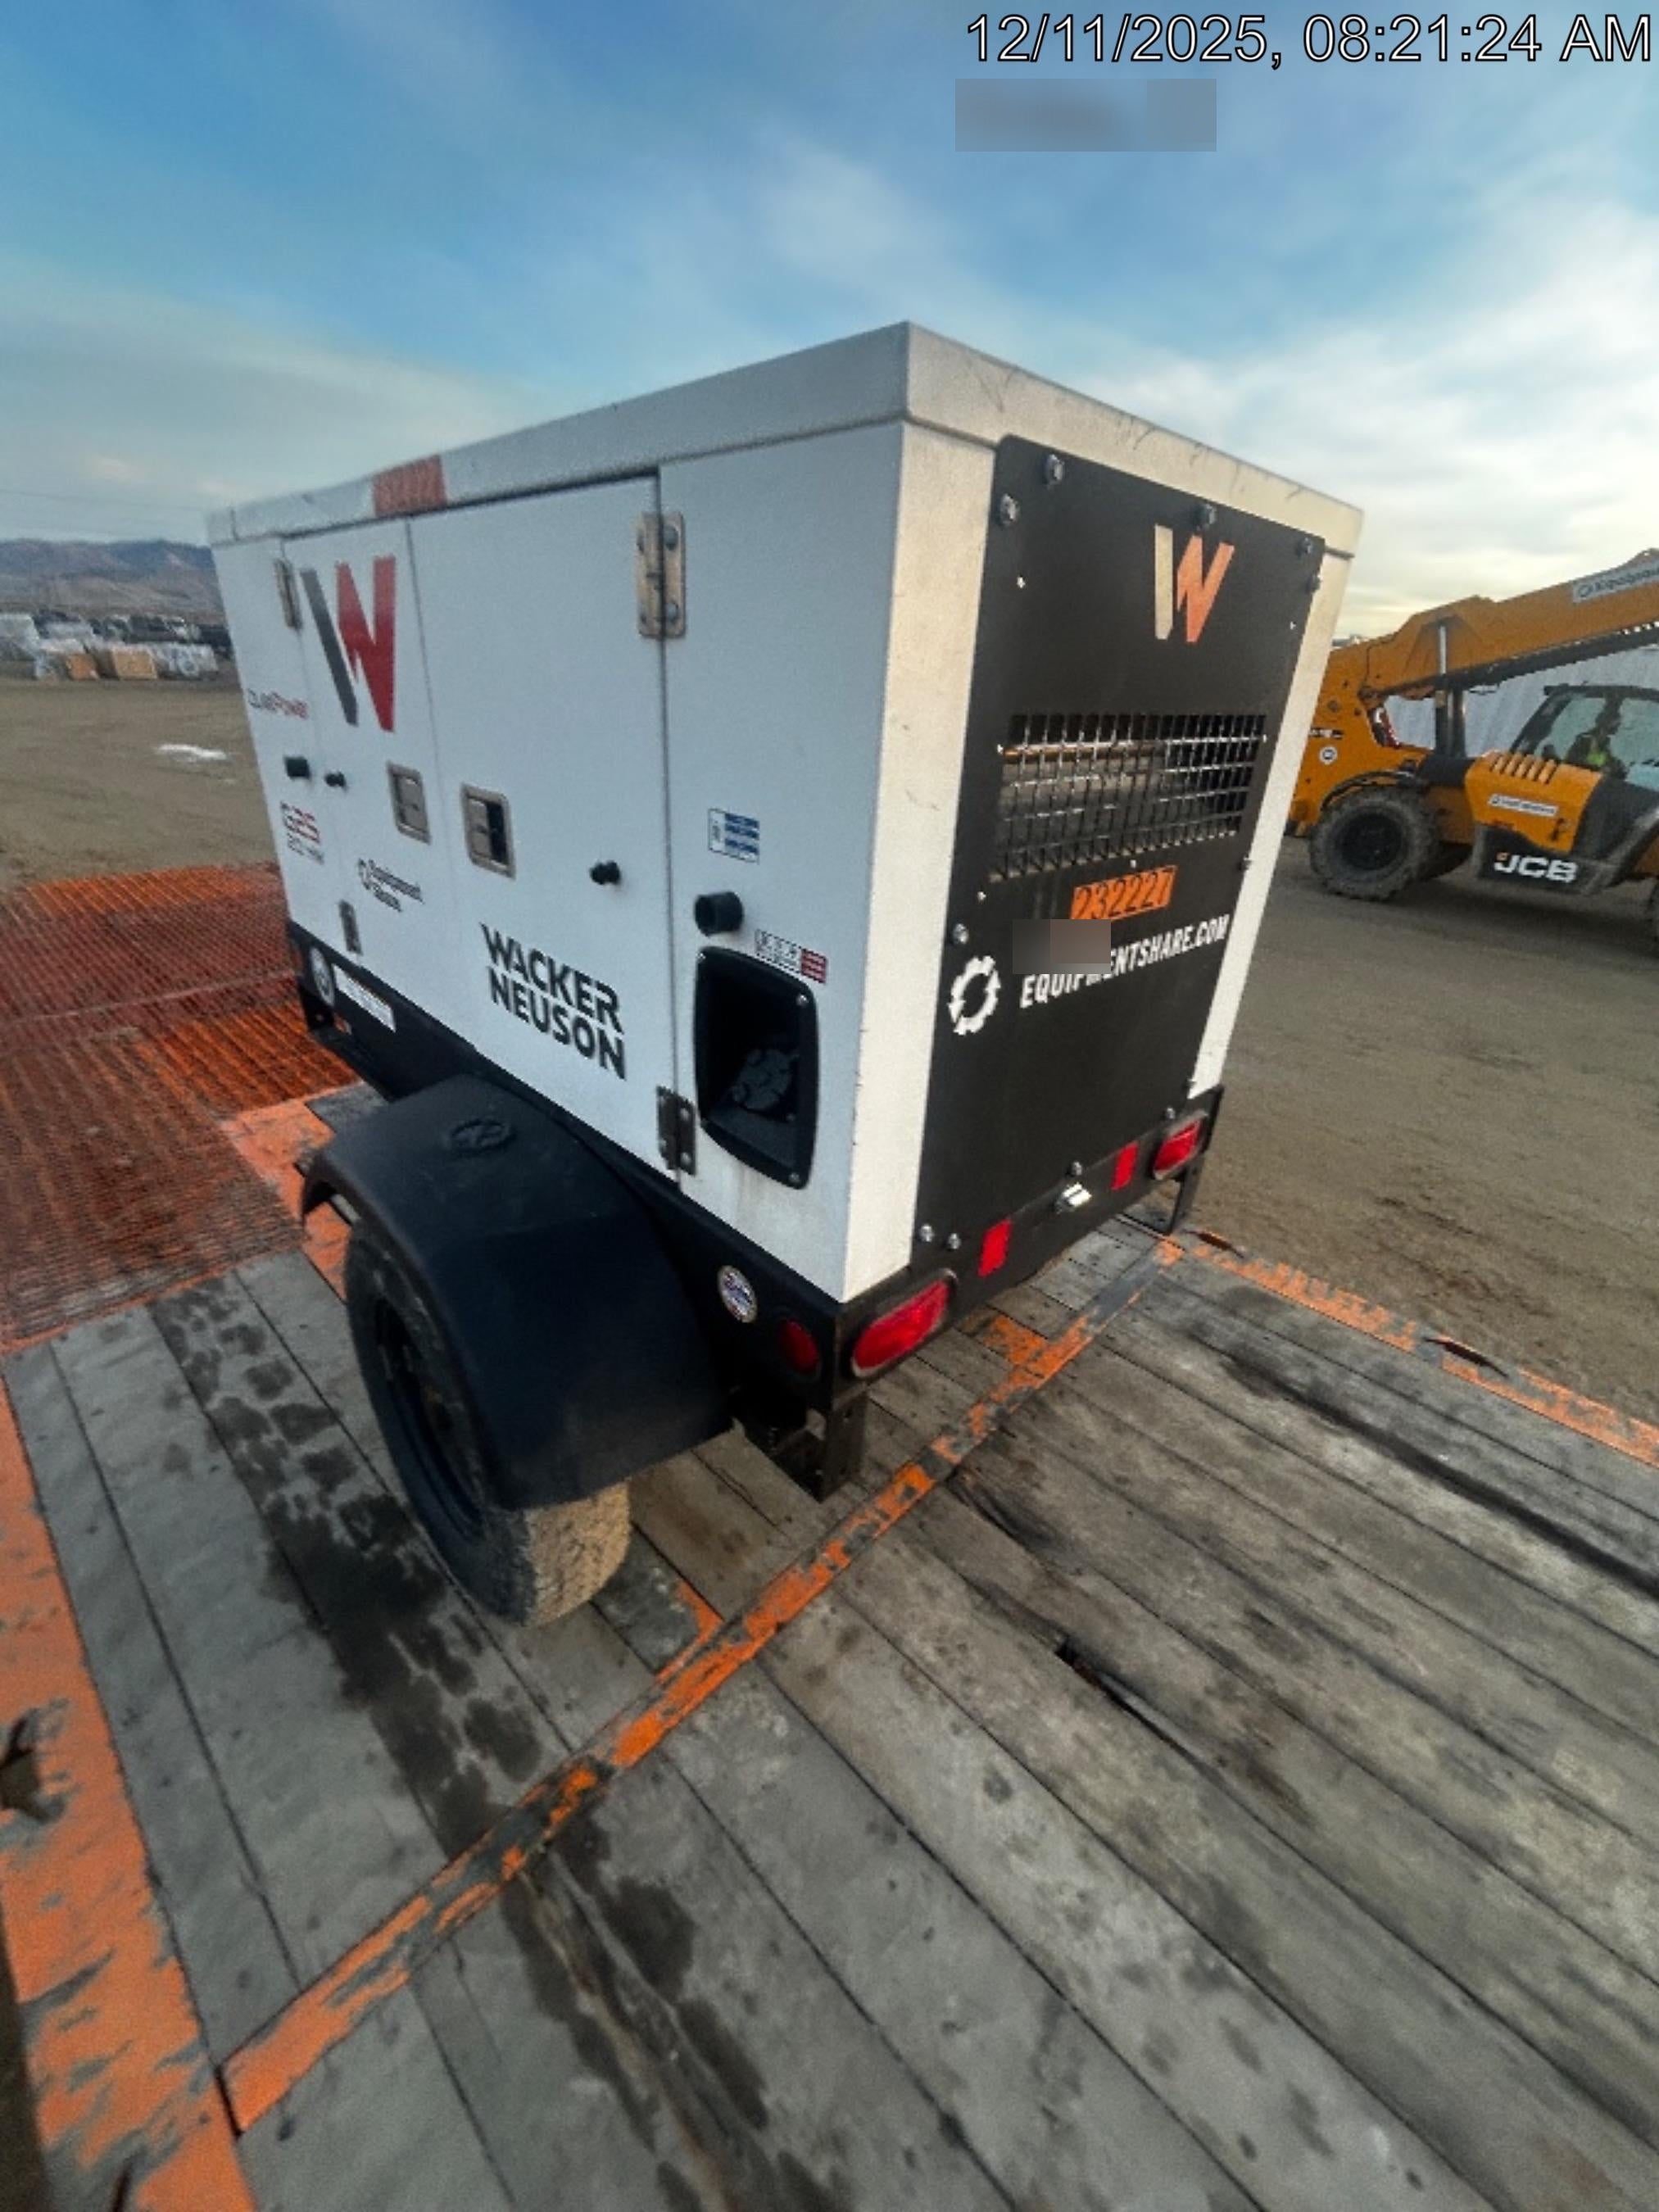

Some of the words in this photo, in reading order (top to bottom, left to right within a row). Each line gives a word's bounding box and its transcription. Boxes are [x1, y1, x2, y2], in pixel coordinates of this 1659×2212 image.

[1075, 866, 1175, 919] 232227
[1494, 853, 1579, 883] JCB
[479, 922, 624, 1035] WACKER
[487, 965, 628, 1081] NEUSON
